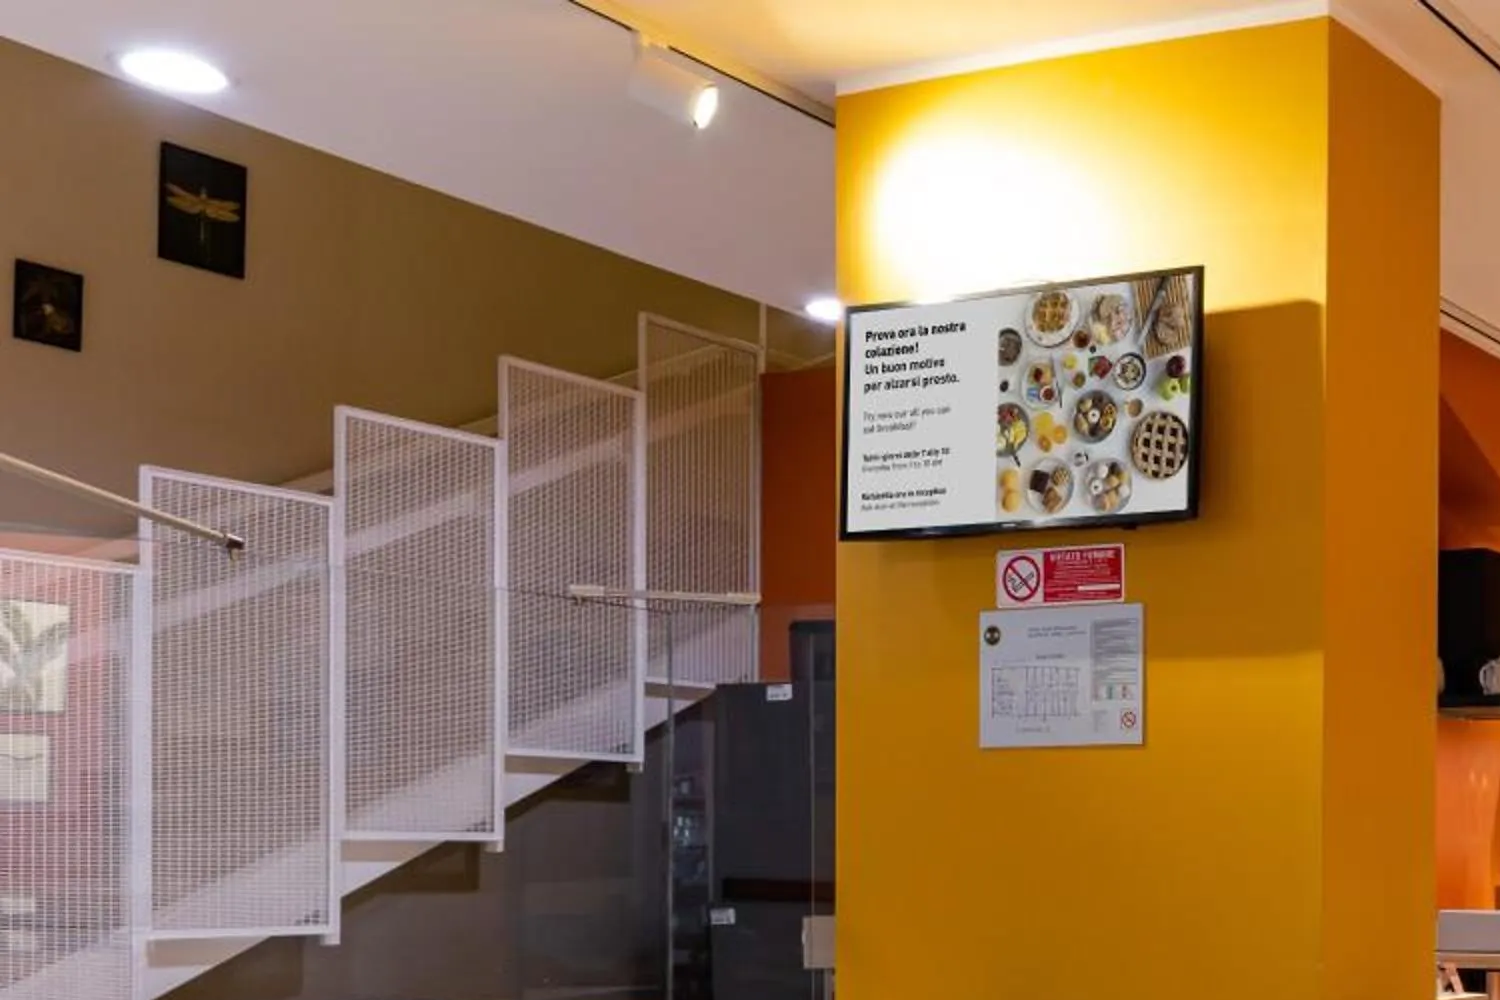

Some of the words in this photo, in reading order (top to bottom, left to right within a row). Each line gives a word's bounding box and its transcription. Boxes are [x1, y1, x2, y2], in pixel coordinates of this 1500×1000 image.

[865, 330, 897, 342] Prova
[898, 328, 916, 339] ora
[918, 324, 929, 336] la
[931, 321, 966, 335] nostra
[864, 363, 879, 375] Un
[881, 361, 907, 373] buon
[863, 381, 882, 394] per
